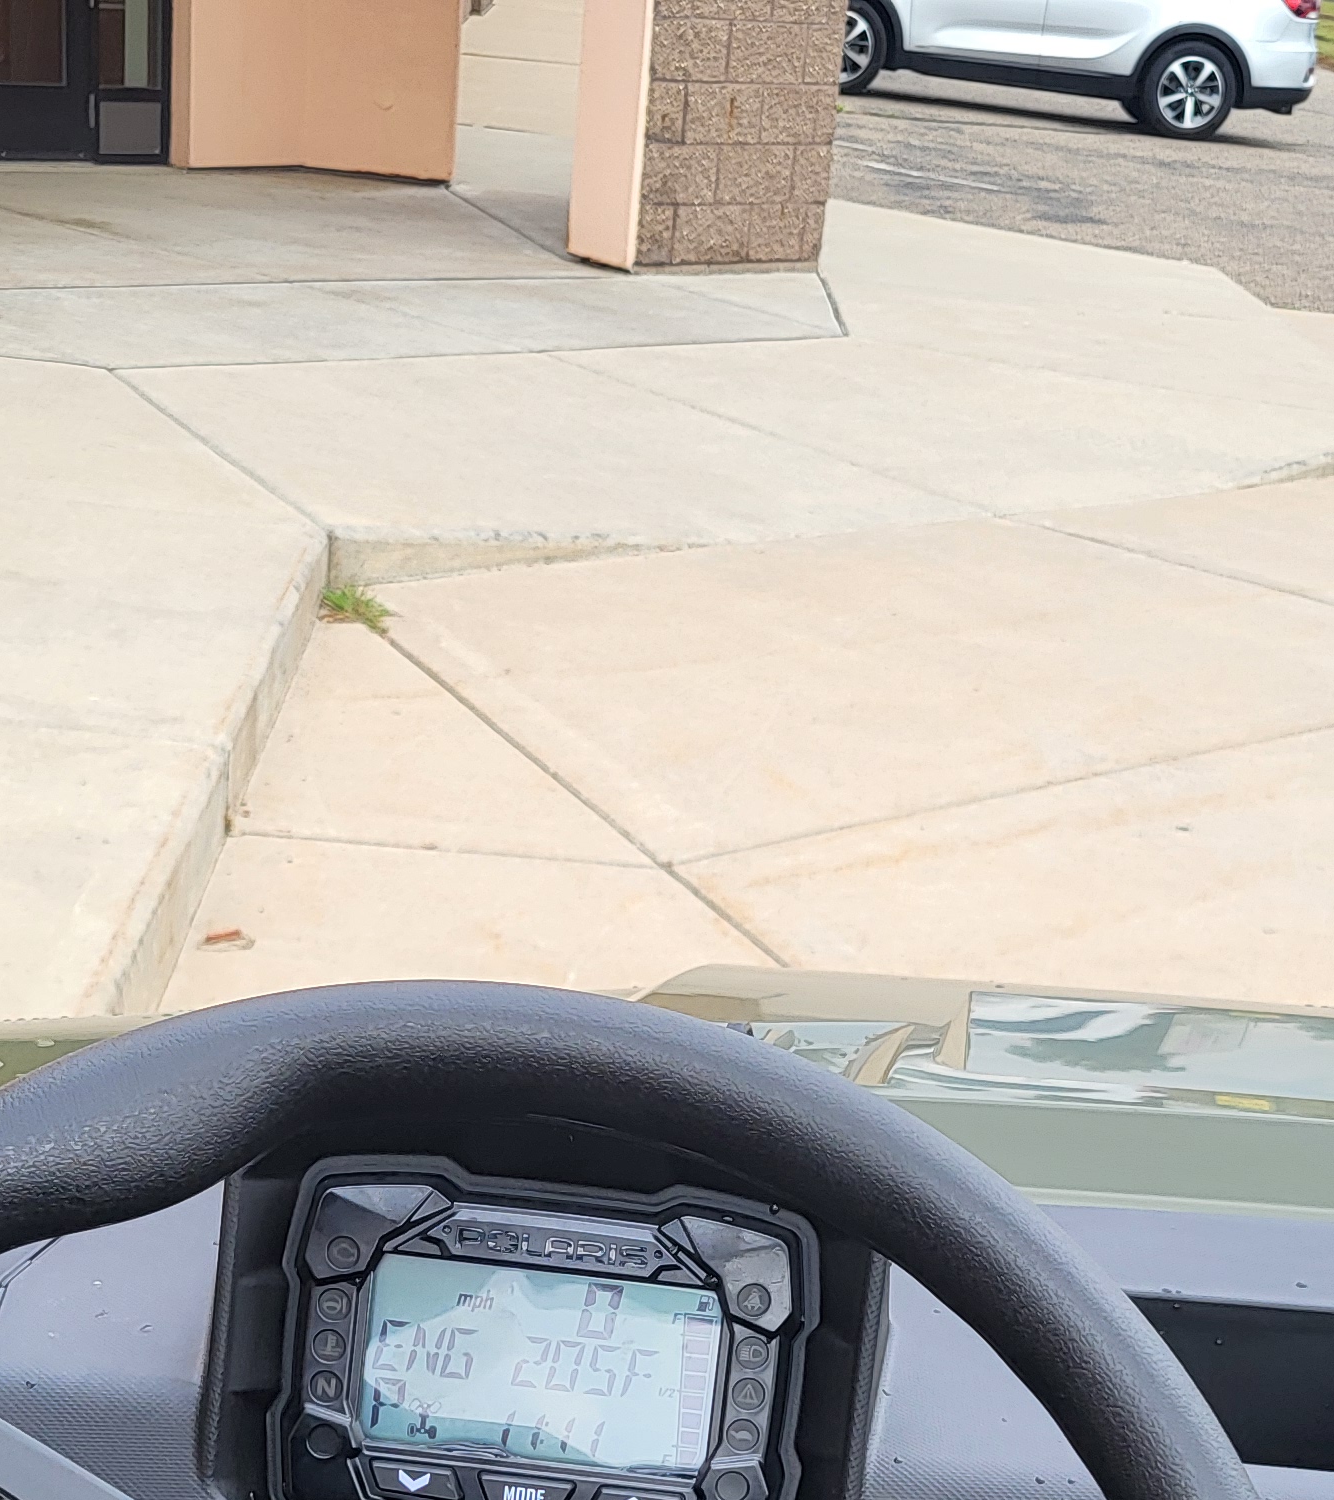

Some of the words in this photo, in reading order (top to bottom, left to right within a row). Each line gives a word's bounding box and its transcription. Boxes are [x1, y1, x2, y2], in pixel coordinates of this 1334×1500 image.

[455, 1225, 648, 1268] POLARIS
[456, 1291, 495, 1311] mph
[576, 1281, 625, 1340] 0
[371, 1318, 479, 1380] ENG
[316, 1376, 337, 1398] N
[370, 1376, 407, 1428] P
